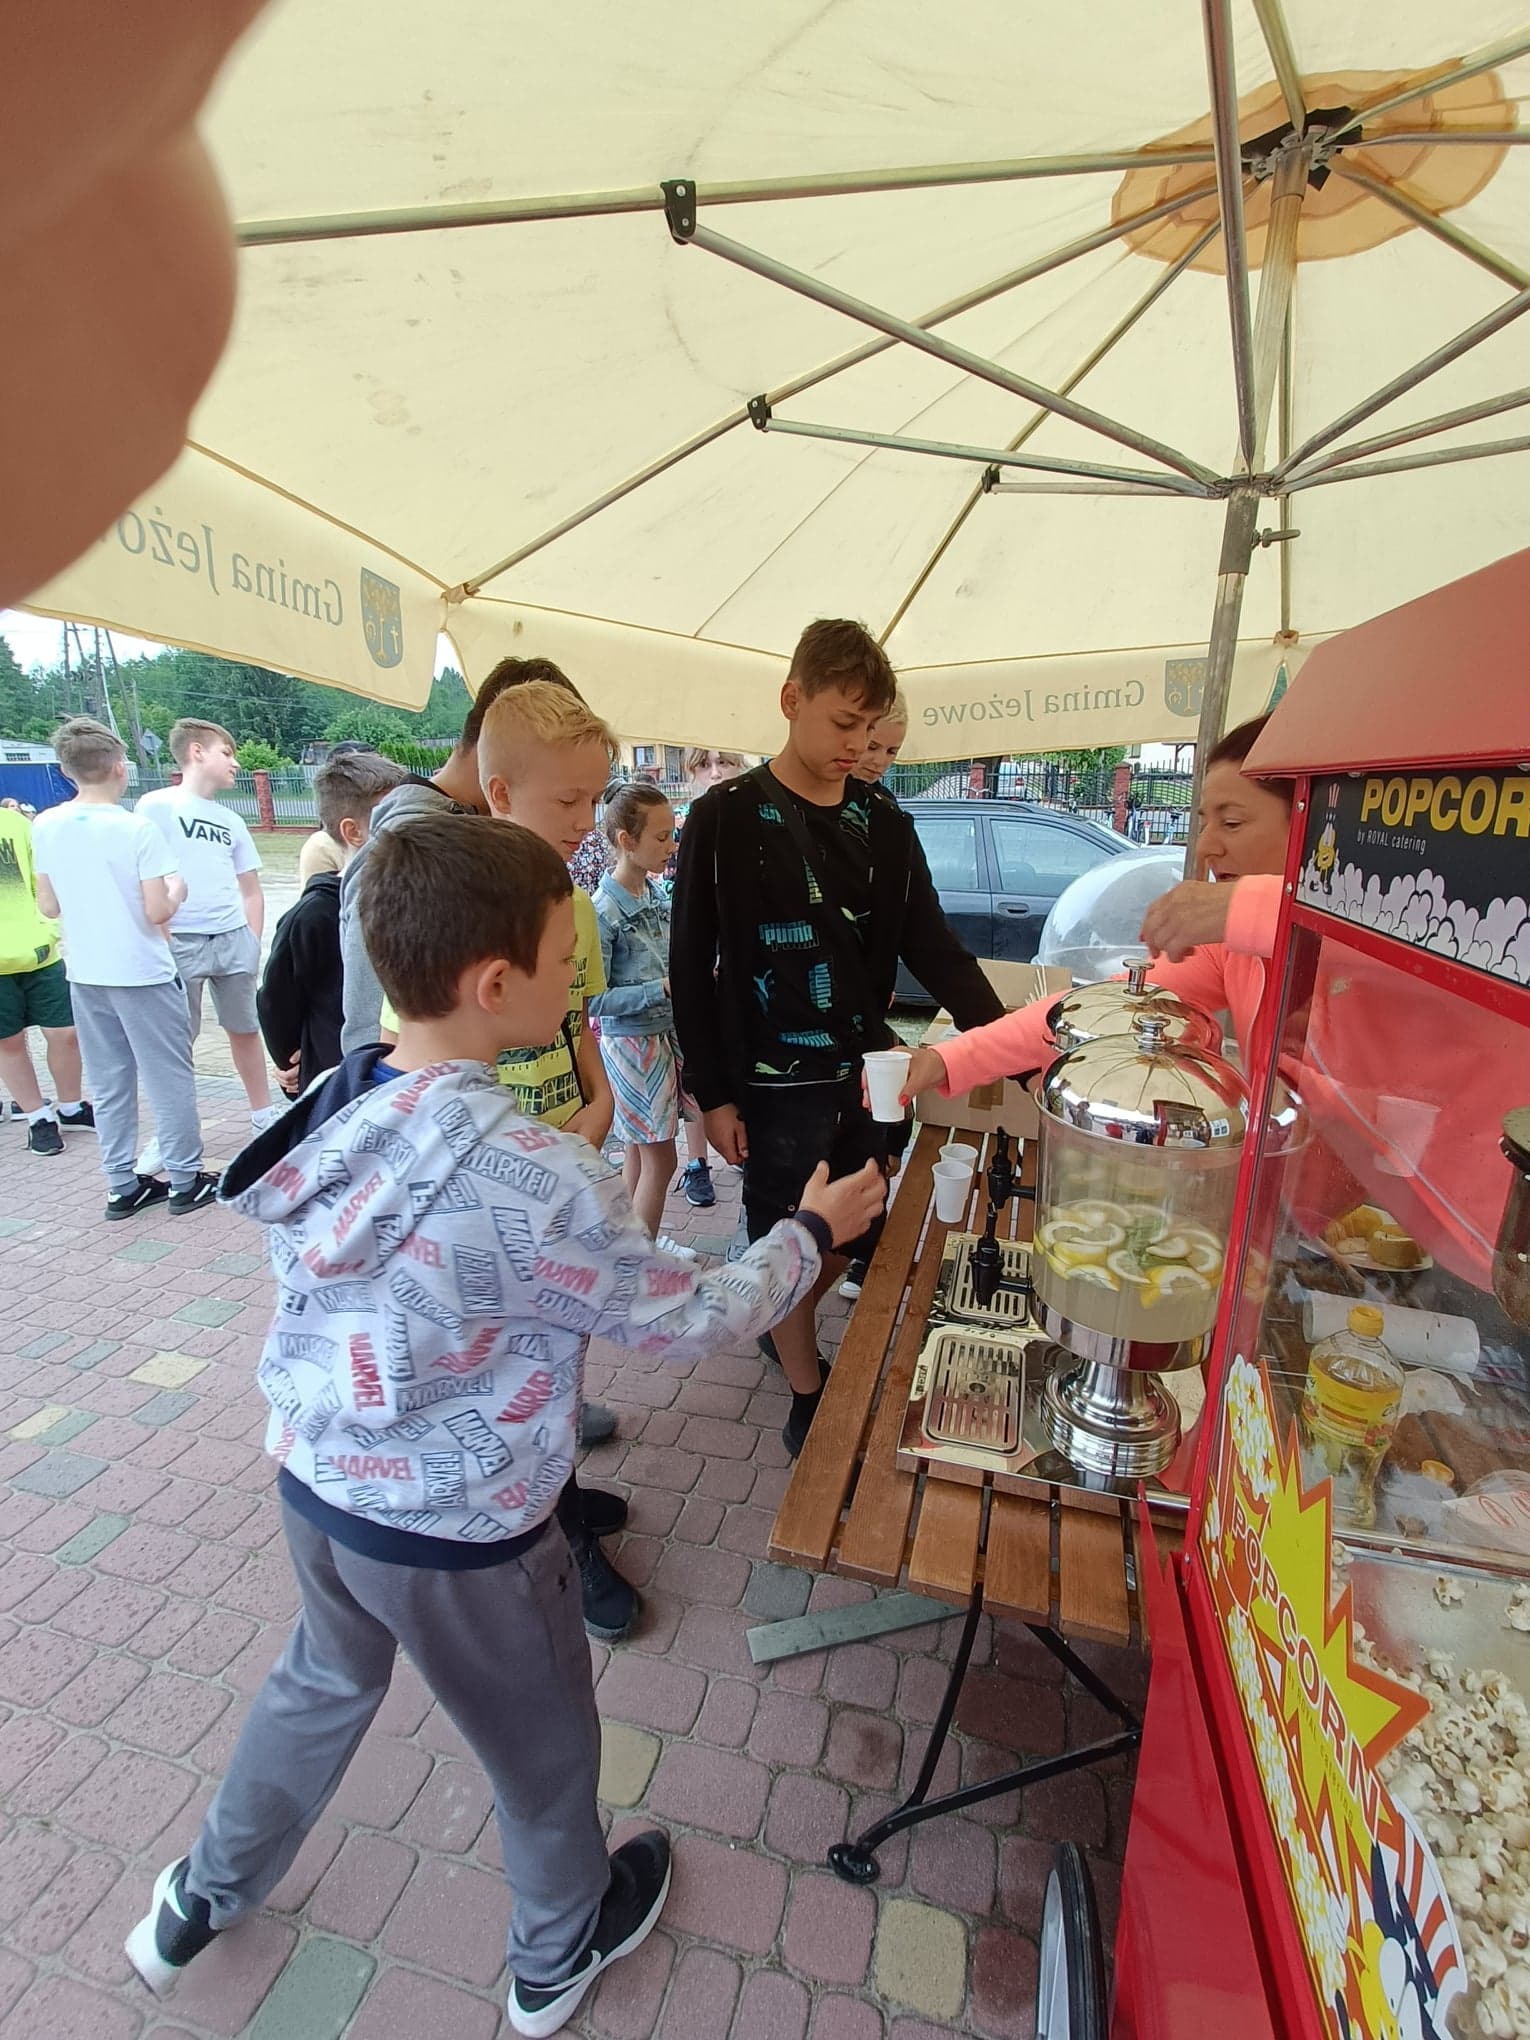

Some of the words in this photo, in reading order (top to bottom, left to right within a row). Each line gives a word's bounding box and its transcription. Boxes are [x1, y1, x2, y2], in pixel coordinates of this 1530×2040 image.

[179, 816, 232, 846] VANS
[1357, 829, 1365, 845] by
[1367, 830, 1389, 846] ROYAL
[1391, 836, 1426, 855] catering
[764, 923, 814, 946] PUMA
[814, 962, 833, 1010] PUMA
[456, 1244, 503, 1314] MARVEL
[350, 1333, 386, 1412] MARVEL
[397, 1369, 494, 1416] MARVEL
[442, 1409, 513, 1478] MARVEL
[328, 1455, 416, 1482] MARVEL
[1231, 1495, 1382, 1845] POPCORN
